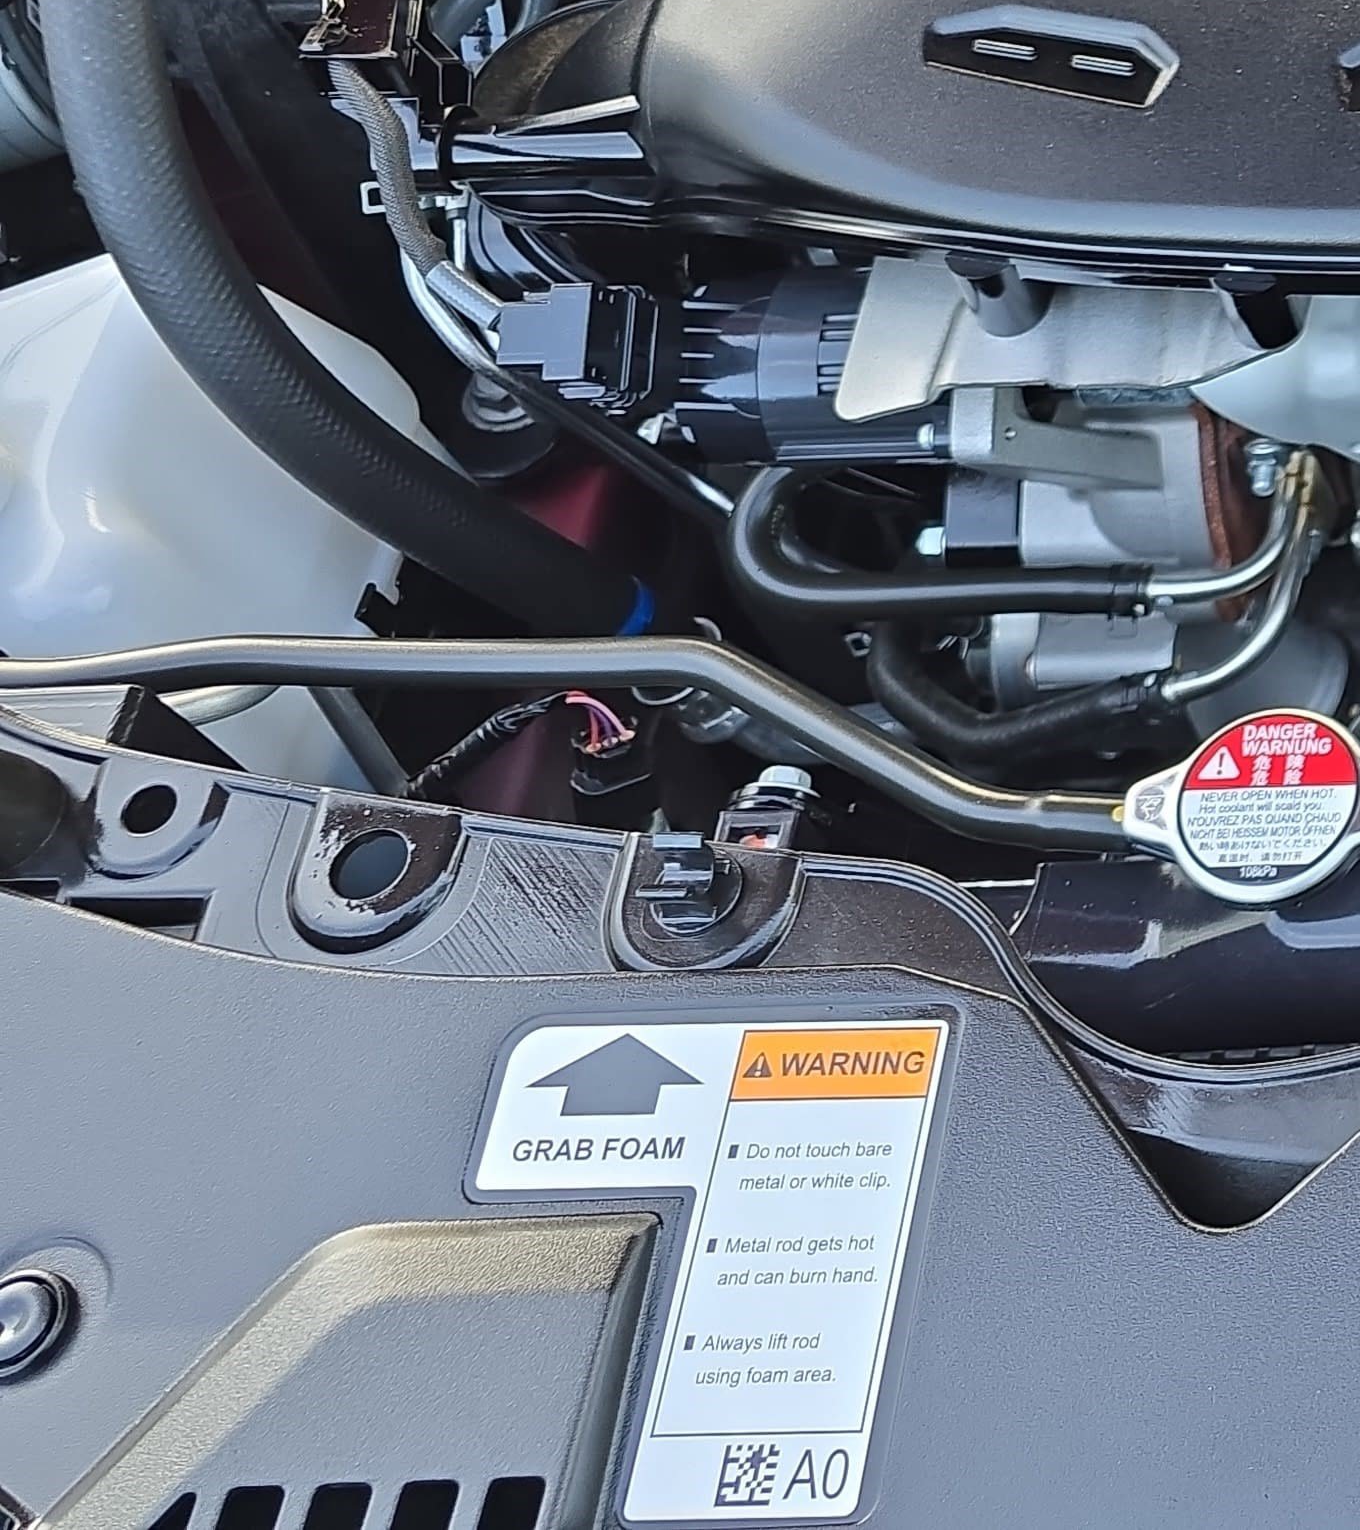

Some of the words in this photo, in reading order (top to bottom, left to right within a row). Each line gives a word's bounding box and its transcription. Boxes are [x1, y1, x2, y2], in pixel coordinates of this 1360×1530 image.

[1243, 722, 1319, 740] DANGER
[1241, 736, 1333, 757] WARNUNG
[1200, 792, 1238, 803] NEVER
[1241, 790, 1272, 801] OPEN
[1275, 789, 1309, 800] WHEN
[1311, 788, 1337, 800] HOT.
[1199, 803, 1217, 813] Hot
[1218, 802, 1254, 813] coolant
[1257, 801, 1273, 811] will
[1275, 800, 1301, 811] scald
[1241, 814, 1262, 825] PAS
[1265, 813, 1302, 824] QUAND
[1304, 812, 1342, 824] CHAUD
[1190, 829, 1214, 840] NICHT
[1216, 828, 1231, 839] BEI
[783, 1051, 925, 1077] WARNING
[513, 1138, 593, 1162] GRAB
[602, 1137, 686, 1161] FOAM
[747, 1144, 770, 1159] Do
[775, 1143, 801, 1159] not
[806, 1142, 850, 1158] touch
[856, 1141, 892, 1157] bare
[740, 1174, 785, 1190] metal
[790, 1177, 808, 1189] or
[812, 1173, 853, 1189] white
[859, 1173, 890, 1191] clip.
[726, 1237, 771, 1253] Metal
[776, 1237, 804, 1253] rod
[807, 1237, 843, 1256] gets
[848, 1235, 874, 1251] hot
[718, 1269, 750, 1285] and
[755, 1273, 784, 1285] can
[789, 1268, 826, 1284] burn
[832, 1267, 878, 1283] hand.
[702, 1335, 763, 1354] Always
[768, 1333, 788, 1350] lift
[793, 1333, 820, 1350] rod
[696, 1368, 742, 1388] using
[747, 1366, 789, 1384] foam
[794, 1369, 836, 1383] area.
[783, 1449, 850, 1500] A0
